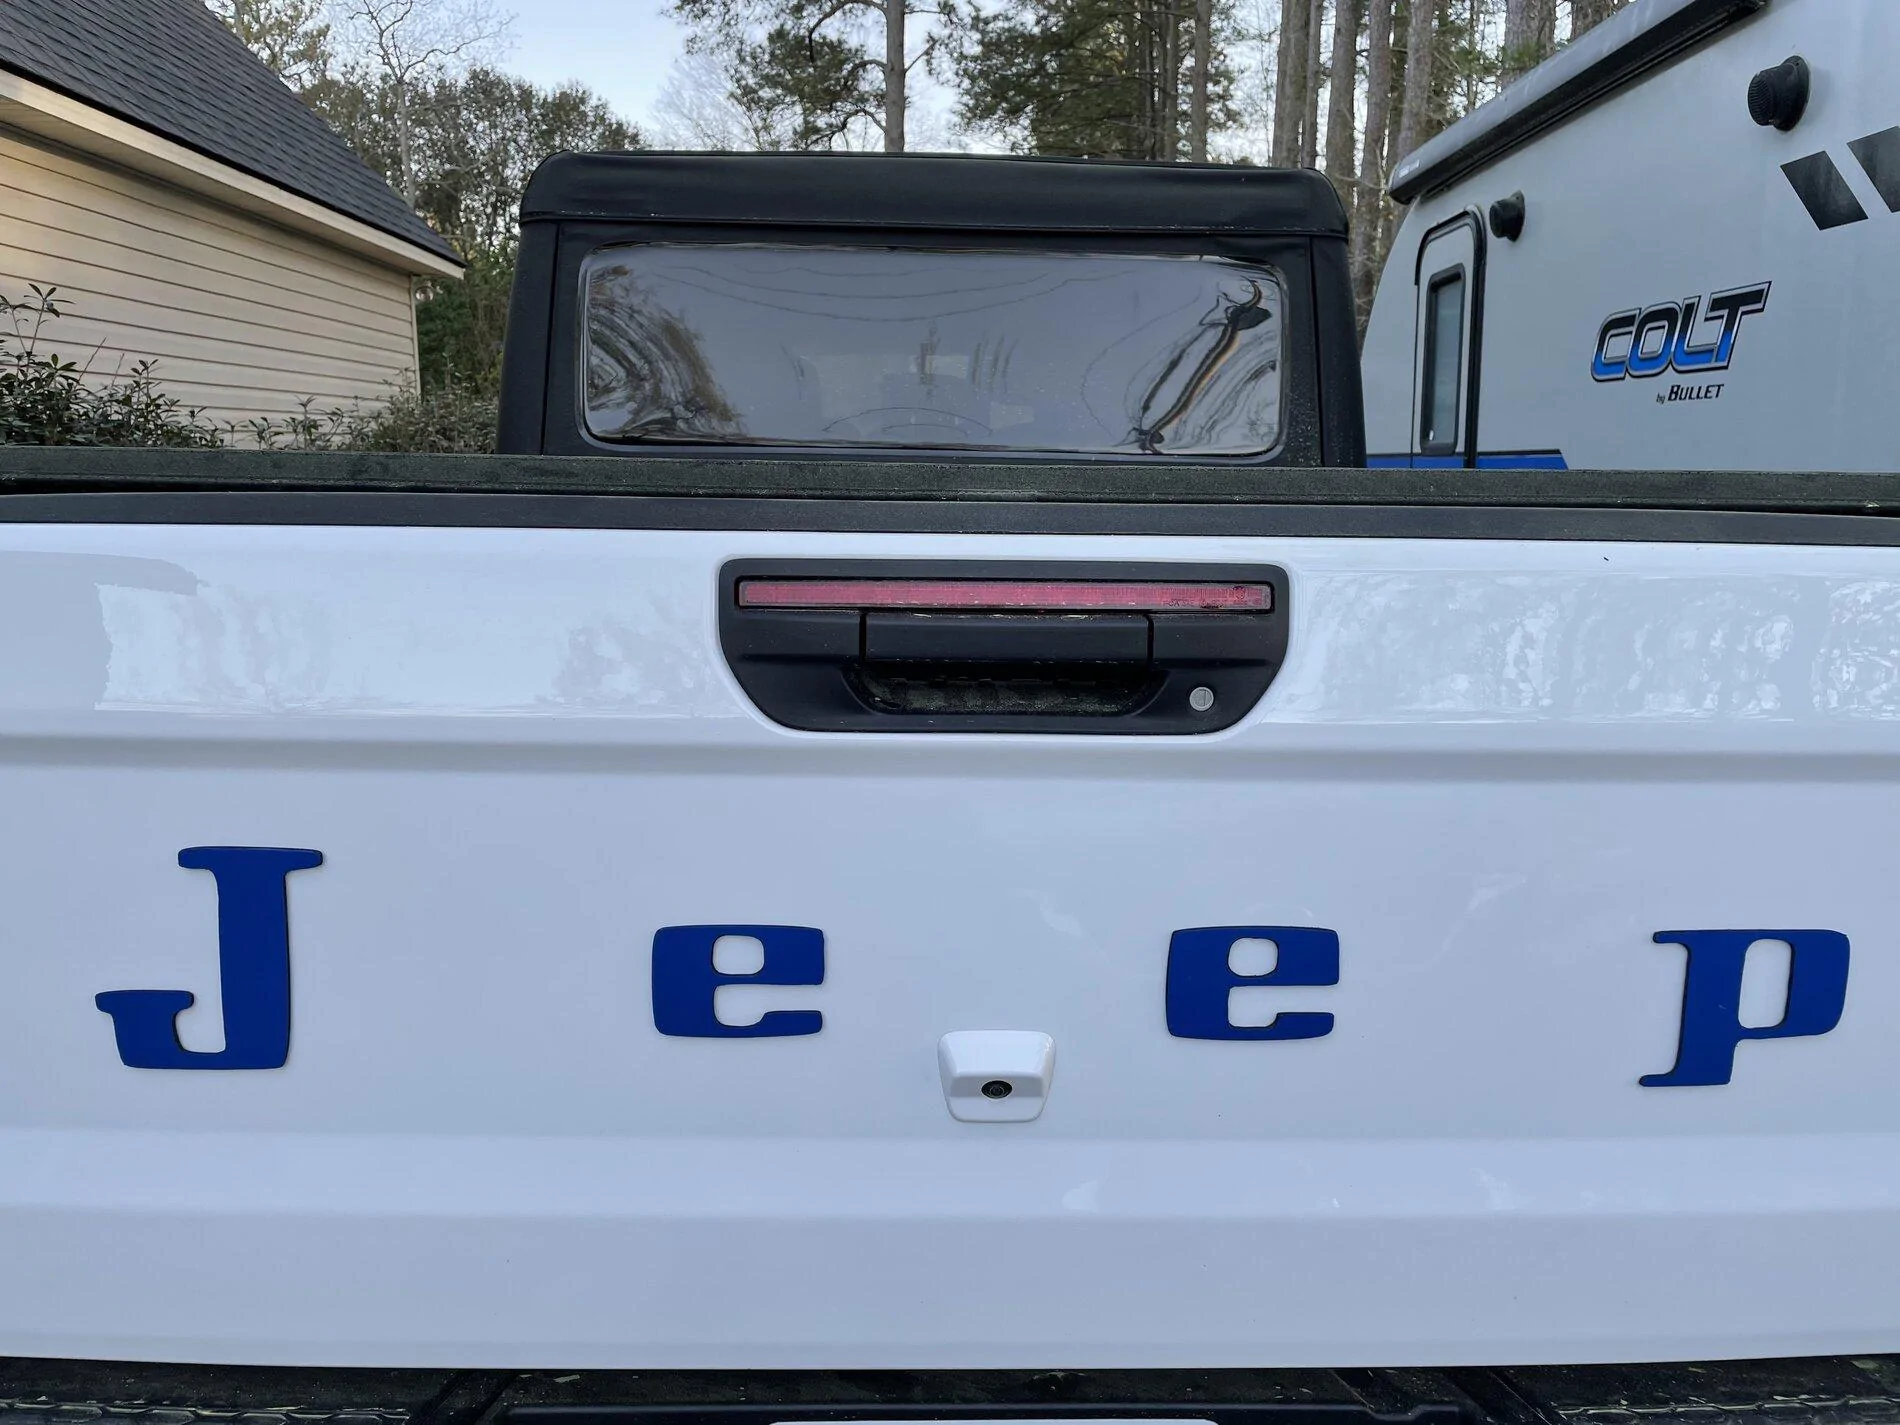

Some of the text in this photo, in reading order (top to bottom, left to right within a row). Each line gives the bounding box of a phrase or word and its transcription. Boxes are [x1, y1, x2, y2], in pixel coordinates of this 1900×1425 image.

[1591, 281, 1772, 382] COLT
[1656, 383, 1725, 404] by BULLET
[95, 846, 1851, 1087] Jeep
